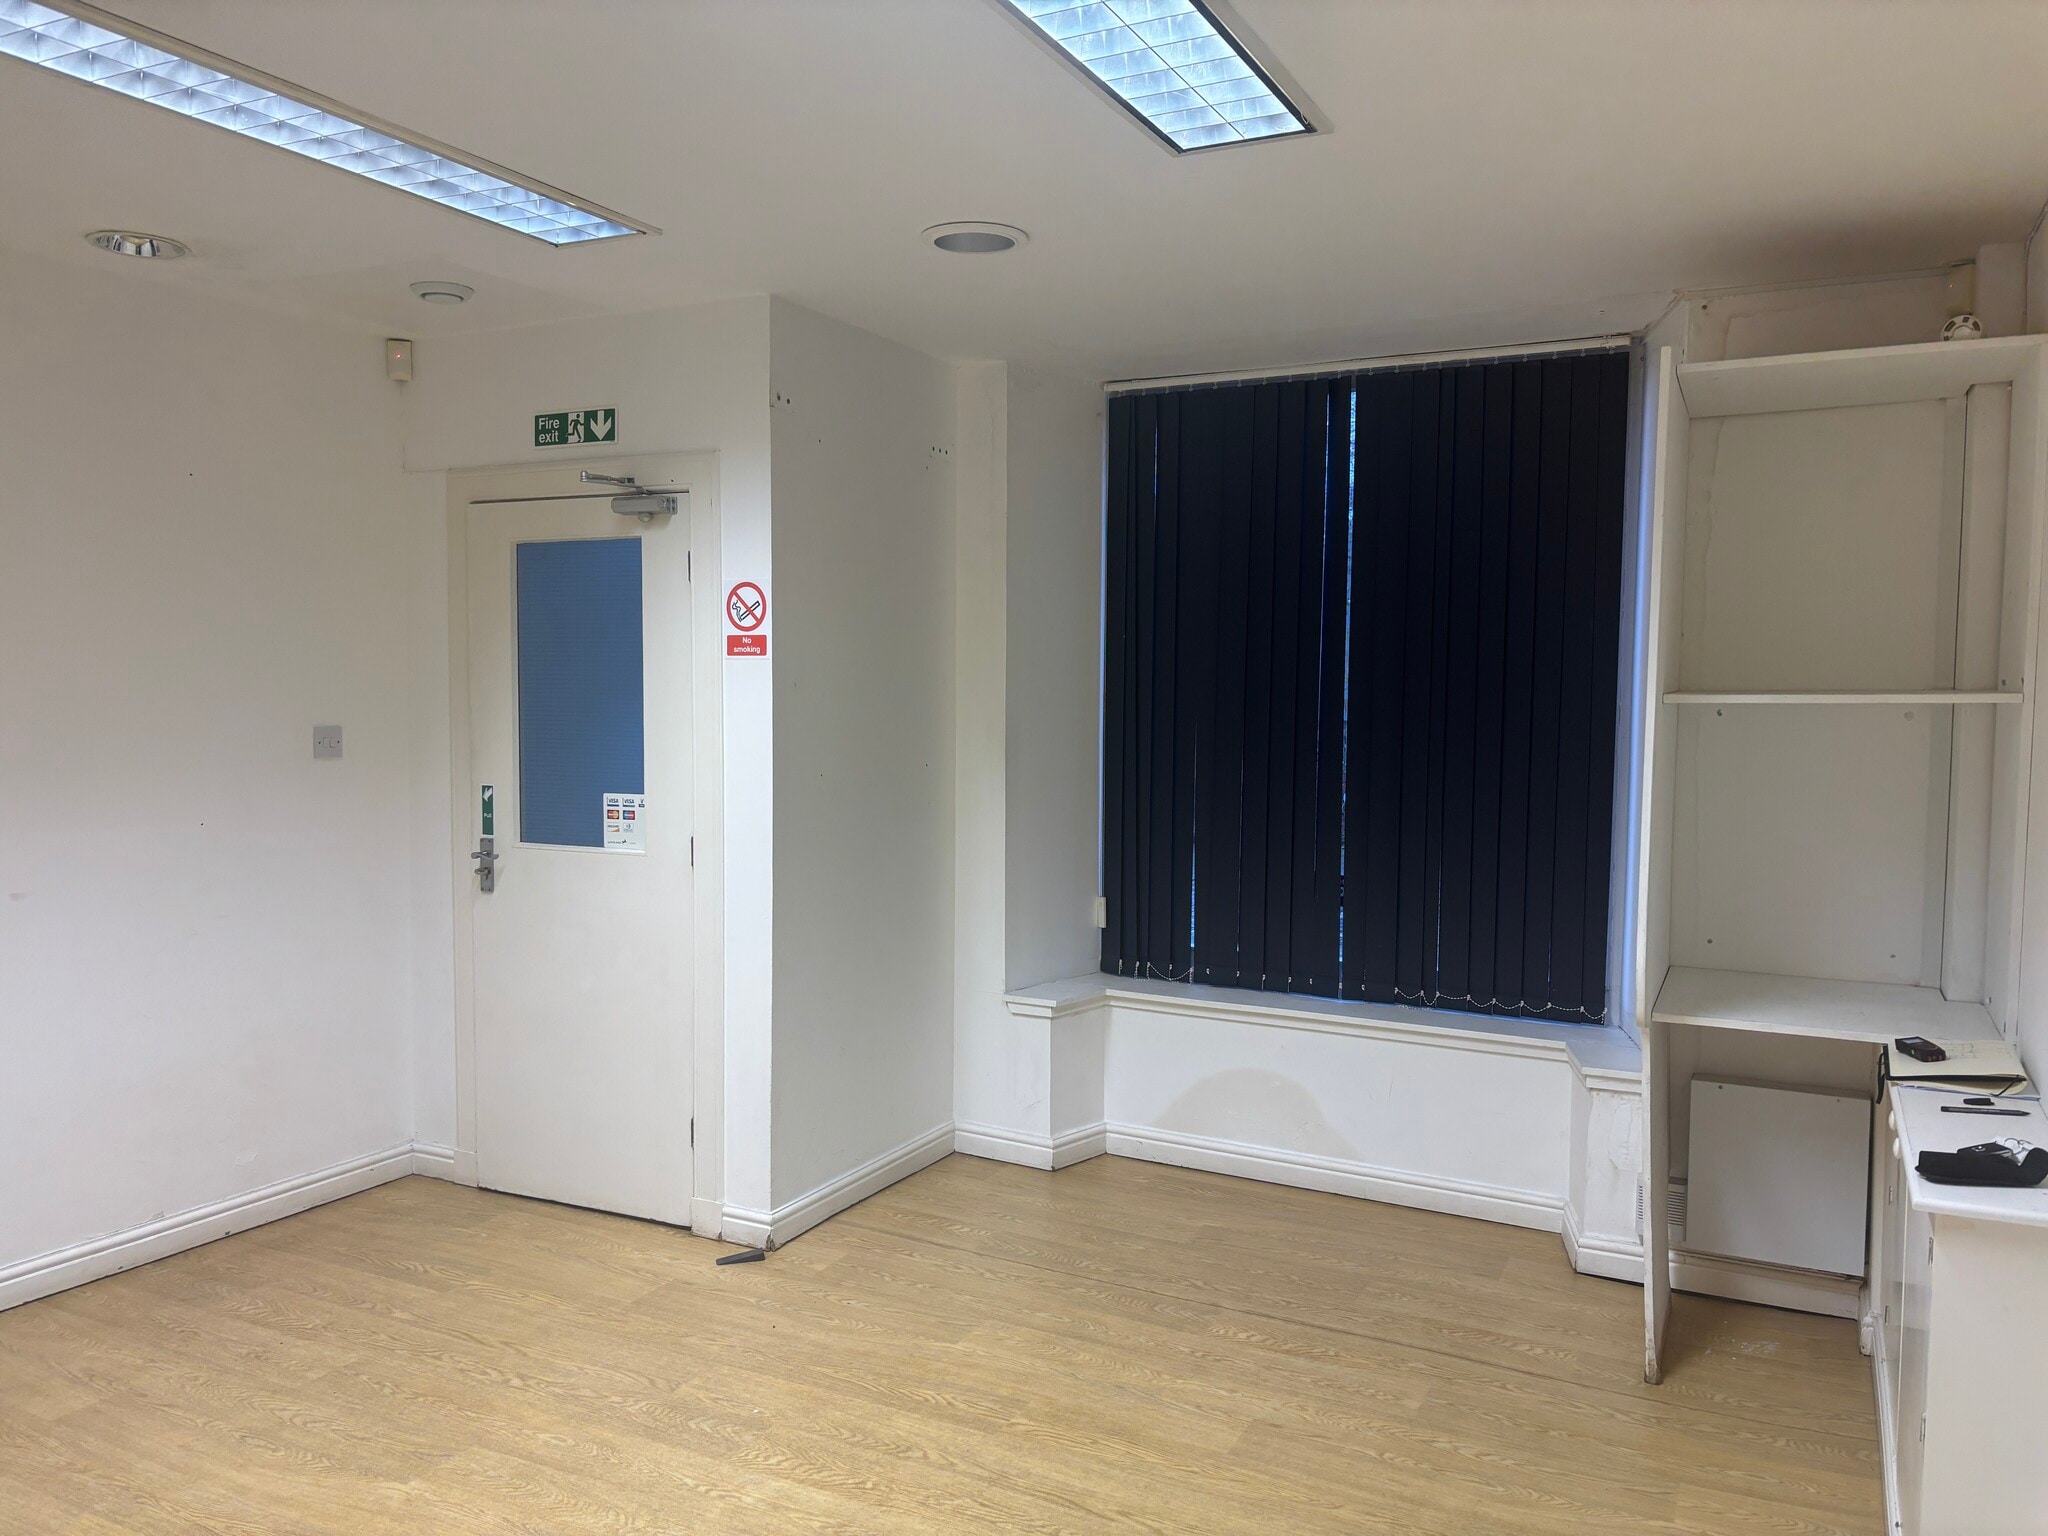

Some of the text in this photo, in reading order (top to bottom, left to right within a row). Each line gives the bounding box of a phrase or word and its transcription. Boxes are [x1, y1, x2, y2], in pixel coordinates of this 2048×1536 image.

[538, 417, 560, 430] Fire
[538, 430, 559, 443] exit
[742, 636, 752, 644] No
[733, 646, 761, 654] smoking
